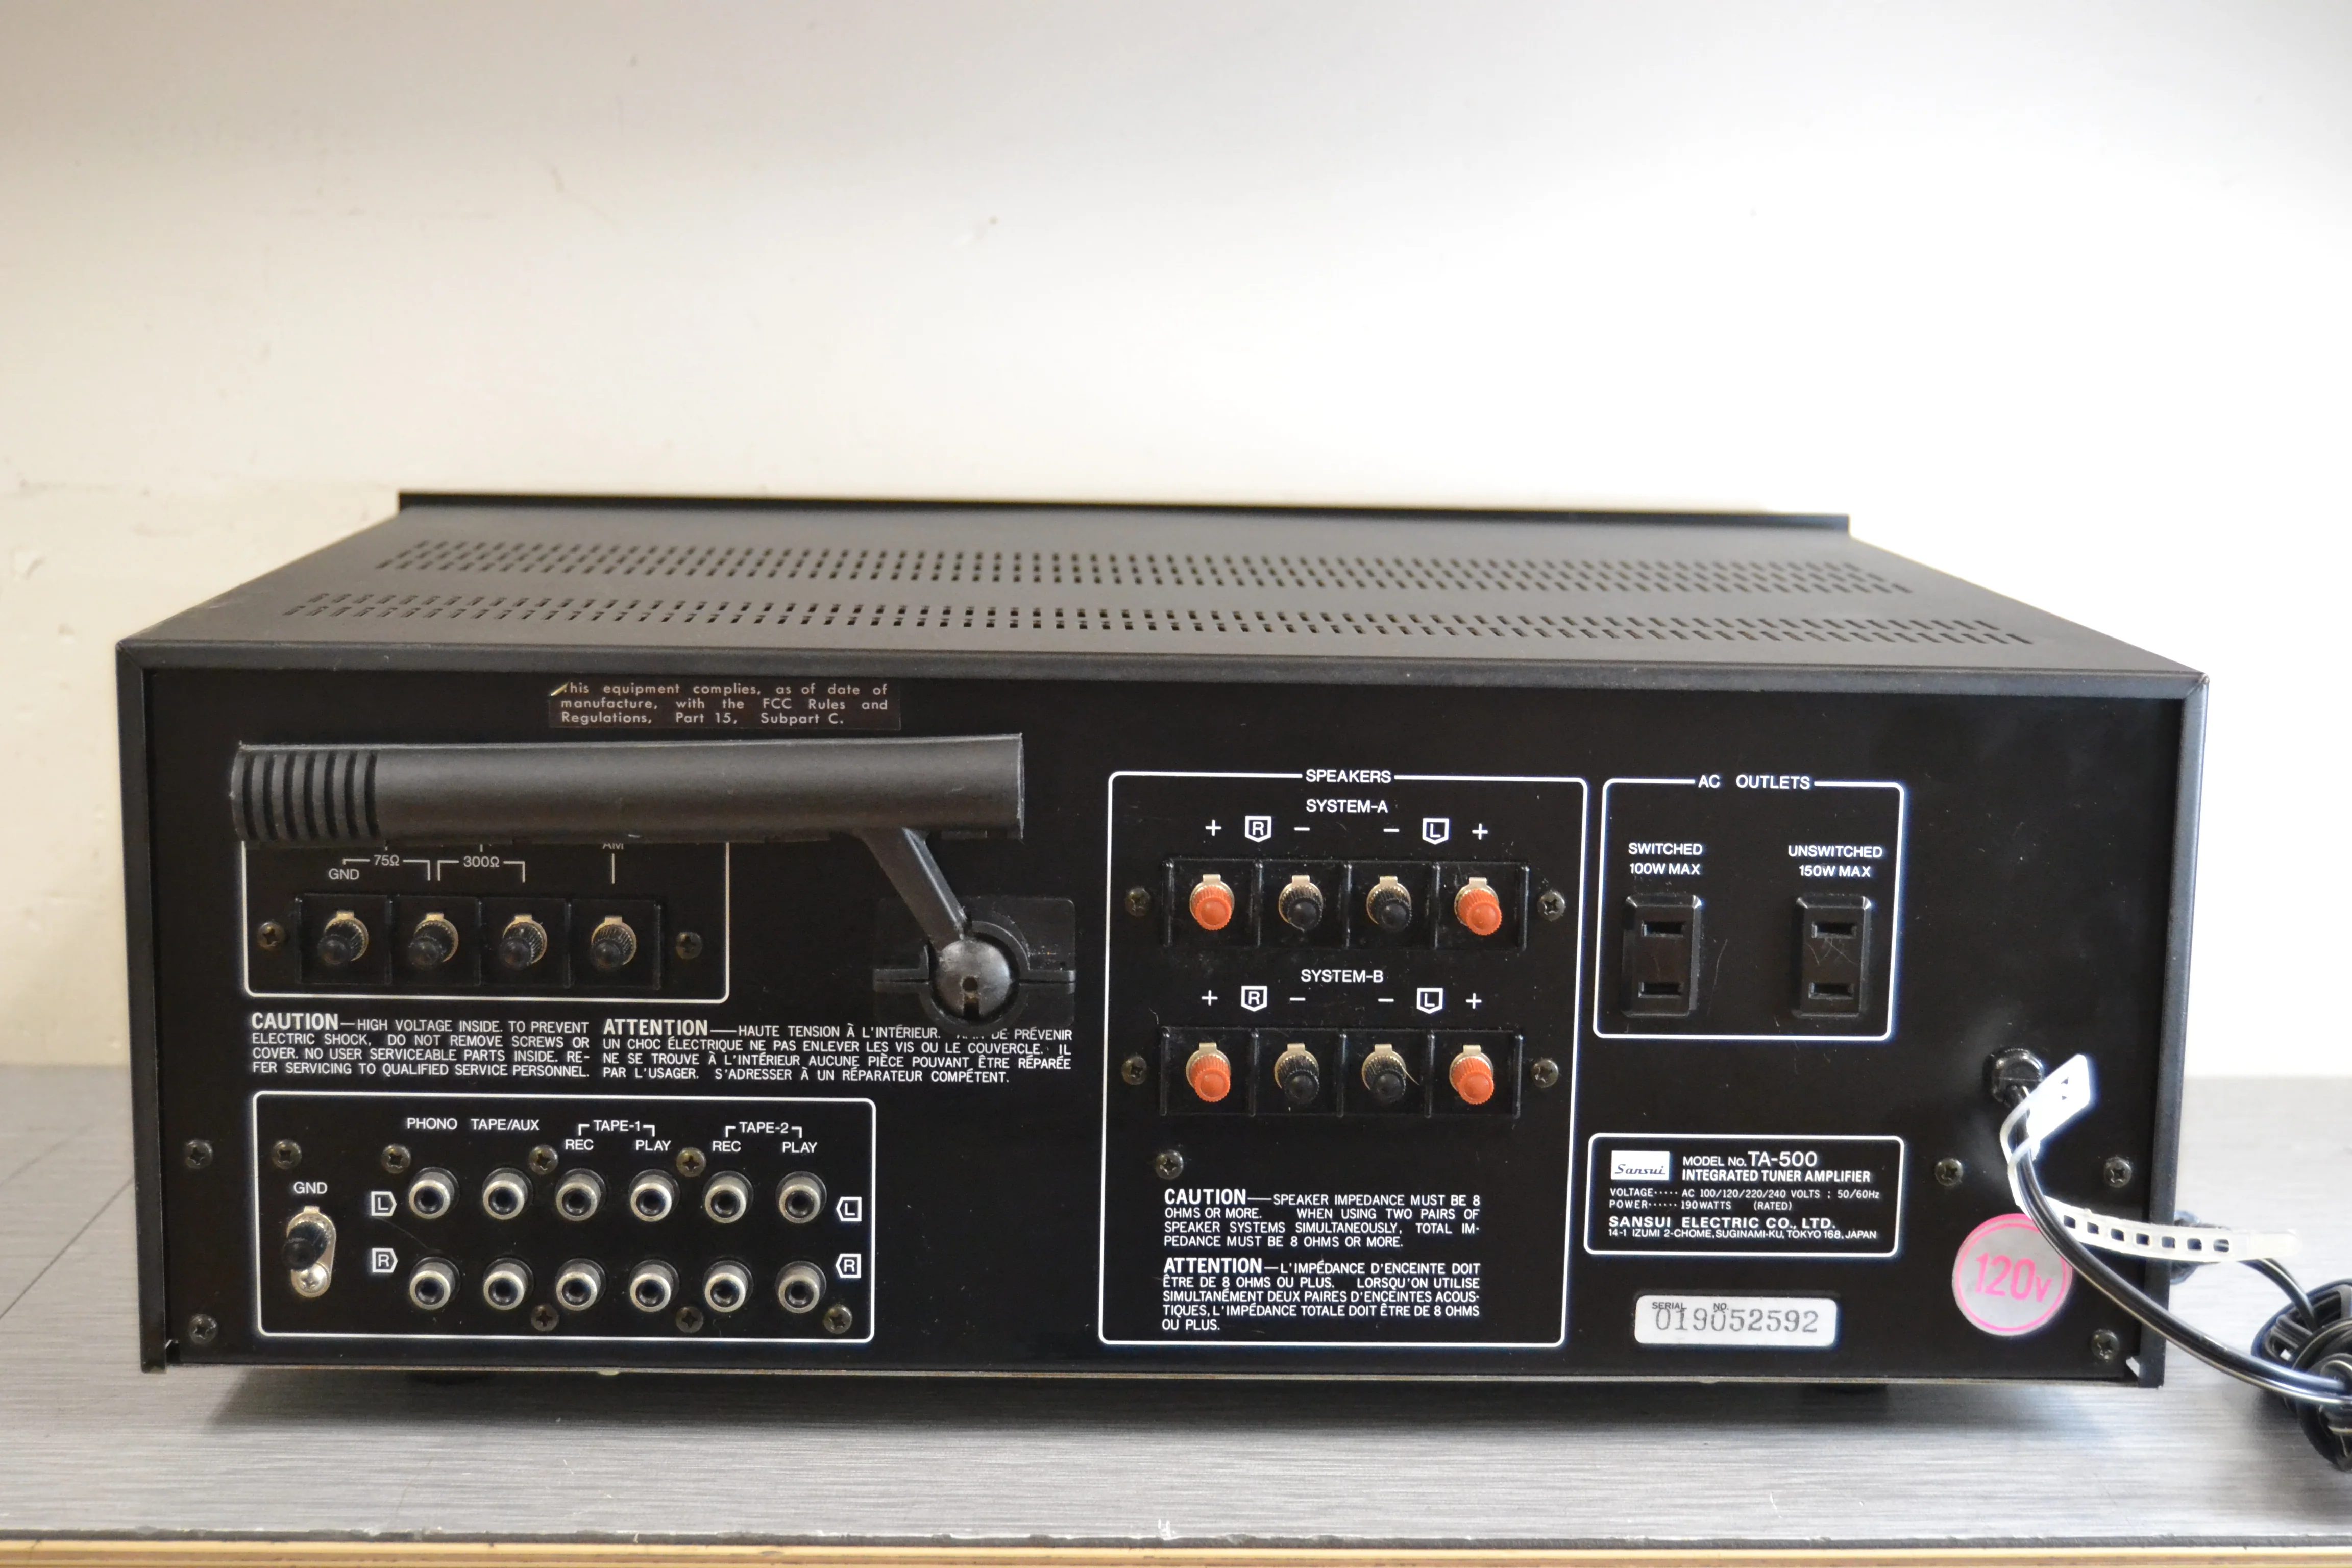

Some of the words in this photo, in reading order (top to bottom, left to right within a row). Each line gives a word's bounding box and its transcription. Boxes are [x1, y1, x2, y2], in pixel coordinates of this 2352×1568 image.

[562, 682, 589, 693] his
[603, 682, 680, 695] equipment
[693, 682, 761, 695] complies,
[801, 682, 816, 695] of
[827, 683, 860, 695] date
[873, 683, 887, 695] of
[560, 698, 657, 710] manufacture,
[675, 698, 705, 709] with
[722, 698, 744, 709] the
[763, 698, 792, 709] FCC
[808, 698, 846, 710] Rules
[861, 699, 888, 710] and
[561, 712, 652, 725] Regulations,
[675, 712, 704, 723] Part
[715, 712, 738, 724] 15,
[761, 712, 820, 726] Subpart
[828, 712, 844, 724] C.
[1305, 769, 1391, 784] SPEAKERS
[1698, 774, 1721, 789] AC
[1735, 774, 1811, 790] OUTLETS
[1306, 798, 1388, 813] SYSTEM-A
[1252, 822, 1264, 835] R
[1430, 824, 1440, 838] L
[1628, 842, 1703, 855] SWITCHED
[1788, 845, 1883, 859] UNSWITCHED
[328, 868, 360, 880] GND
[1629, 862, 1666, 875] 100W
[1668, 863, 1701, 875] MAX
[1799, 864, 1836, 877] 150W
[1839, 865, 1872, 878] MAX
[1301, 969, 1384, 983] SYSTEM-B
[1248, 992, 1260, 1004] R
[1425, 993, 1436, 1007] L
[357, 1018, 388, 1031] HIGH
[395, 1019, 453, 1032] VOLTAGE
[459, 1020, 503, 1033] INSIDE.
[508, 1020, 526, 1033] TO
[531, 1021, 589, 1034] PREVENT
[739, 1025, 780, 1037] HAUTE
[788, 1025, 840, 1037] TENSION
[846, 1024, 855, 1038] À
[862, 1025, 941, 1039] L'INTÉRIEUR.
[1014, 1026, 1072, 1041] PRÉVENIR
[252, 1032, 315, 1045] ELECTRIC
[324, 1033, 372, 1046] SHOCK,
[387, 1034, 406, 1046] DO
[414, 1034, 441, 1046] NOT
[450, 1035, 503, 1047] REMOVE
[511, 1035, 564, 1048] SCREWS
[572, 1036, 590, 1049] OR
[252, 1046, 299, 1059] COVER.
[304, 1047, 324, 1060] NO
[329, 1047, 362, 1060] USER
[370, 1047, 457, 1061] SERVICEABLE
[463, 1049, 505, 1062] PARTS
[514, 1050, 558, 1063] INSIDE.
[567, 1050, 590, 1063] RE-
[252, 1061, 278, 1073] FER
[285, 1061, 352, 1075] SERVICING
[358, 1063, 376, 1075] TO
[382, 1062, 449, 1076] QUALIFIED
[454, 1063, 508, 1076] SERVICE
[512, 1064, 590, 1077] PERSONNEL.
[603, 1067, 626, 1079] PAR
[635, 1067, 699, 1079] L'USAGER.
[715, 1068, 792, 1080] S'ADRESSER
[800, 1066, 809, 1081] À
[817, 1069, 835, 1081] UN
[842, 1067, 923, 1082] RÉPARATEUR
[930, 1068, 1009, 1083] COMPÉTENT.
[406, 1117, 458, 1130] PHONO
[470, 1118, 540, 1131] TAPE/AUX
[593, 1119, 640, 1132] TAPE-1
[739, 1121, 789, 1134] TAPE-2
[565, 1139, 594, 1151] REC
[635, 1139, 671, 1152] PLAY
[712, 1140, 741, 1153] REC
[782, 1141, 818, 1153] PLAY
[1682, 1156, 1725, 1167] MODEL
[1728, 1156, 1746, 1167] No.
[1746, 1150, 1818, 1167] TA-500
[1614, 1164, 1665, 1175] Sansui
[1682, 1169, 1759, 1182] INTEGRATED
[1761, 1169, 1802, 1182] TUNER
[1804, 1170, 1871, 1183] AMPLIFIER
[293, 1181, 328, 1194] GND
[1681, 1188, 1695, 1198] AC
[1700, 1188, 1786, 1199] 100/120/220/240
[1791, 1189, 1820, 1199] VOLTS
[1837, 1188, 1880, 1199] 50/60Hz
[377, 1197, 389, 1210] L
[1273, 1194, 1329, 1206] SPEAKER
[1334, 1194, 1405, 1206] IMPEDANCE
[1410, 1194, 1446, 1206] MUST
[1451, 1194, 1466, 1207] BE
[1473, 1194, 1481, 1207] 8
[1753, 1200, 1792, 1211] (RATED)
[844, 1202, 856, 1216] L
[1164, 1207, 1201, 1219] OHMS
[1205, 1207, 1221, 1219] OR
[1225, 1207, 1262, 1219] MORE.
[1296, 1208, 1333, 1219] WHEN
[1341, 1208, 1377, 1220] USING
[1385, 1208, 1413, 1220] TWO
[1420, 1208, 1456, 1220] PAIRS
[1463, 1208, 1480, 1220] OF
[1164, 1221, 1220, 1233] SPEAKER
[1230, 1221, 1286, 1233] SYSTEMS
[1295, 1221, 1402, 1235] SIMULTANEOUSLY,
[1415, 1222, 1453, 1234] TOTAL
[1461, 1222, 1480, 1234] IM-
[1608, 1216, 1671, 1228] SANSUI
[1681, 1216, 1759, 1229] ELECTRIC
[1766, 1217, 1797, 1230] CO.,
[1802, 1217, 1836, 1231] LTD.
[1608, 1228, 1627, 1237] 14-1
[1632, 1228, 1660, 1238] IZUMI
[1786, 1228, 1822, 1239] TOKYO
[1845, 1230, 1877, 1239] JAPAN
[378, 1255, 390, 1267] R
[843, 1259, 855, 1272] R
[1280, 1259, 1365, 1275] L'IMPÉDANCE
[1370, 1262, 1446, 1275] D'ENCEINTE
[1452, 1263, 1481, 1275] DOIT
[1163, 1275, 1194, 1288] ÊTRE
[1199, 1276, 1216, 1288] DE
[1222, 1276, 1230, 1288] 8
[1236, 1276, 1271, 1288] OHMS
[1276, 1276, 1294, 1288] OU
[1300, 1276, 1335, 1289] PLUS.
[1357, 1277, 1428, 1289] LORSQU'ON
[1433, 1277, 1480, 1289] UTILISE
[1652, 1302, 1687, 1310] SERIAL
[1162, 1318, 1179, 1331] OU
[1185, 1318, 1220, 1331] PLUS.
[1655, 1308, 1819, 1333] 019052592
